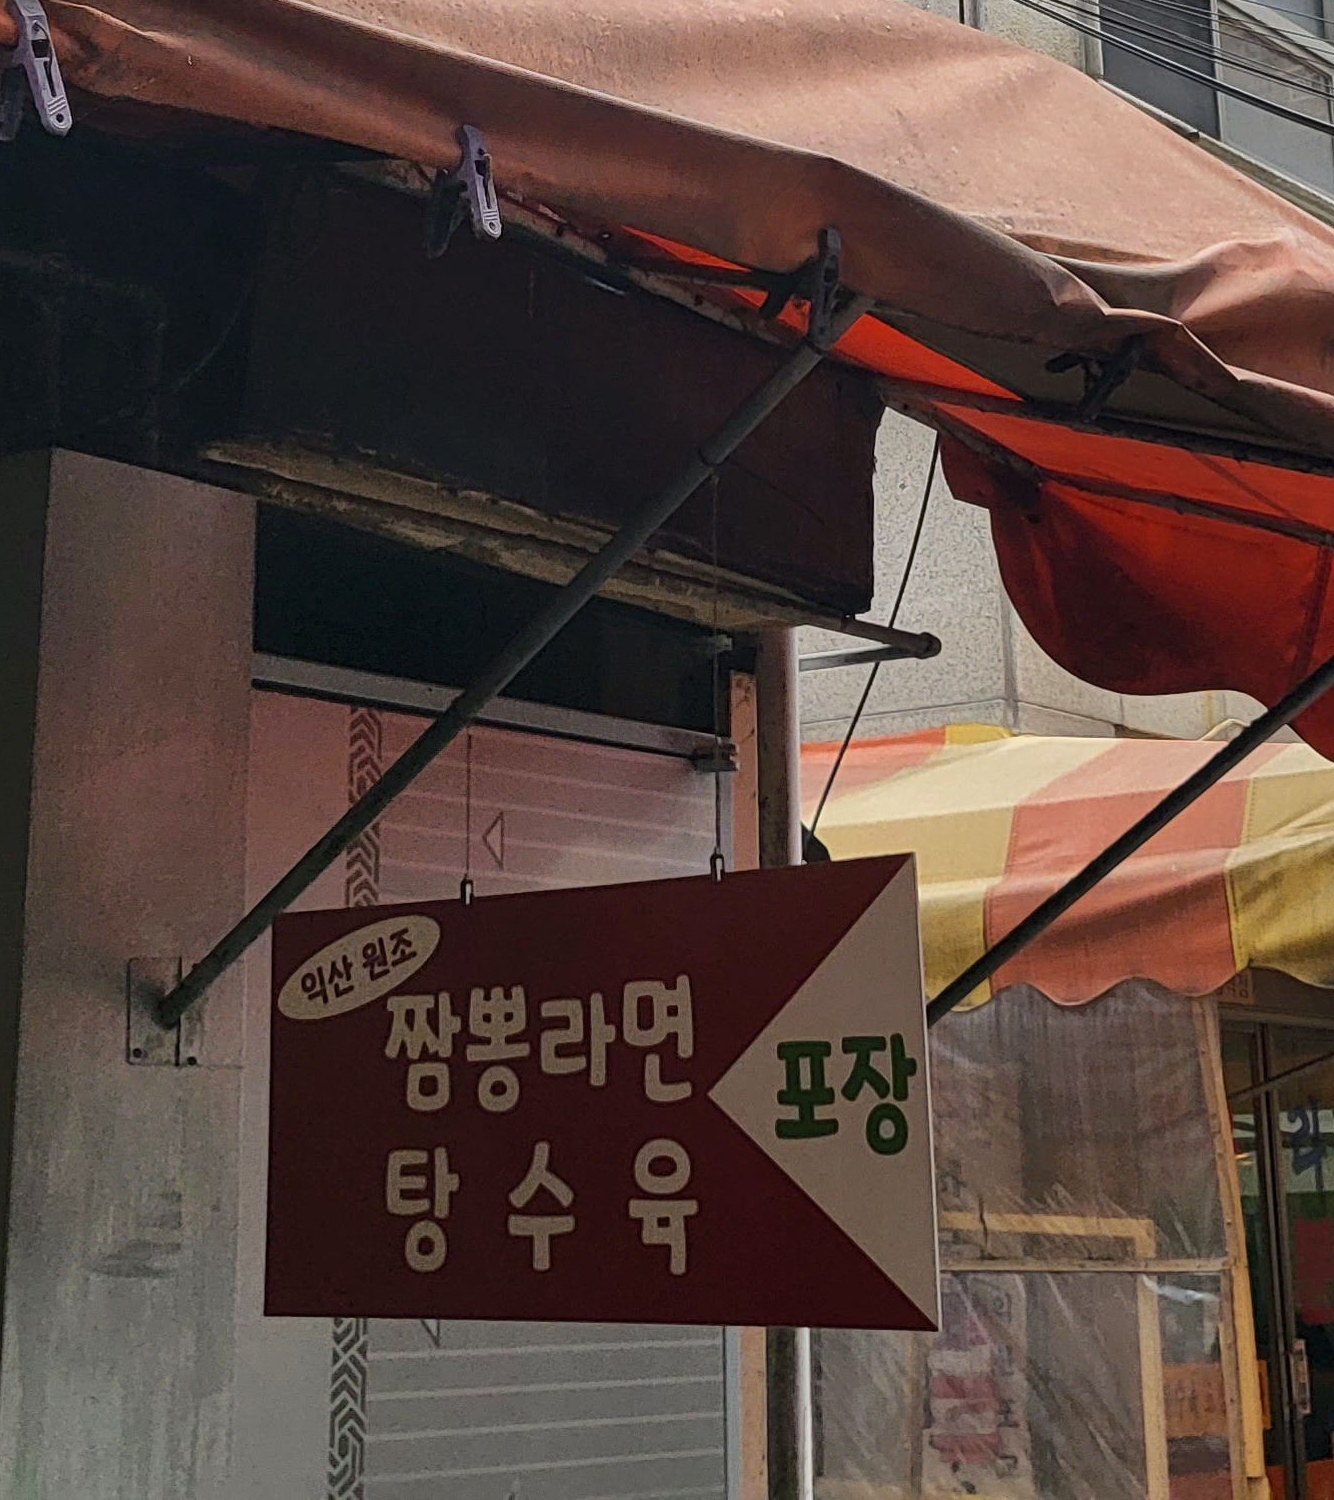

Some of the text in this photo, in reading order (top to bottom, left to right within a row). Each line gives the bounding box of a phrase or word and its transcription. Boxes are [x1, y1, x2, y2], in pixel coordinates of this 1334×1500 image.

[301, 927, 417, 1004] 익산 원조
[384, 975, 695, 1111] 짬뽕라면
[775, 1034, 917, 1155] 포장
